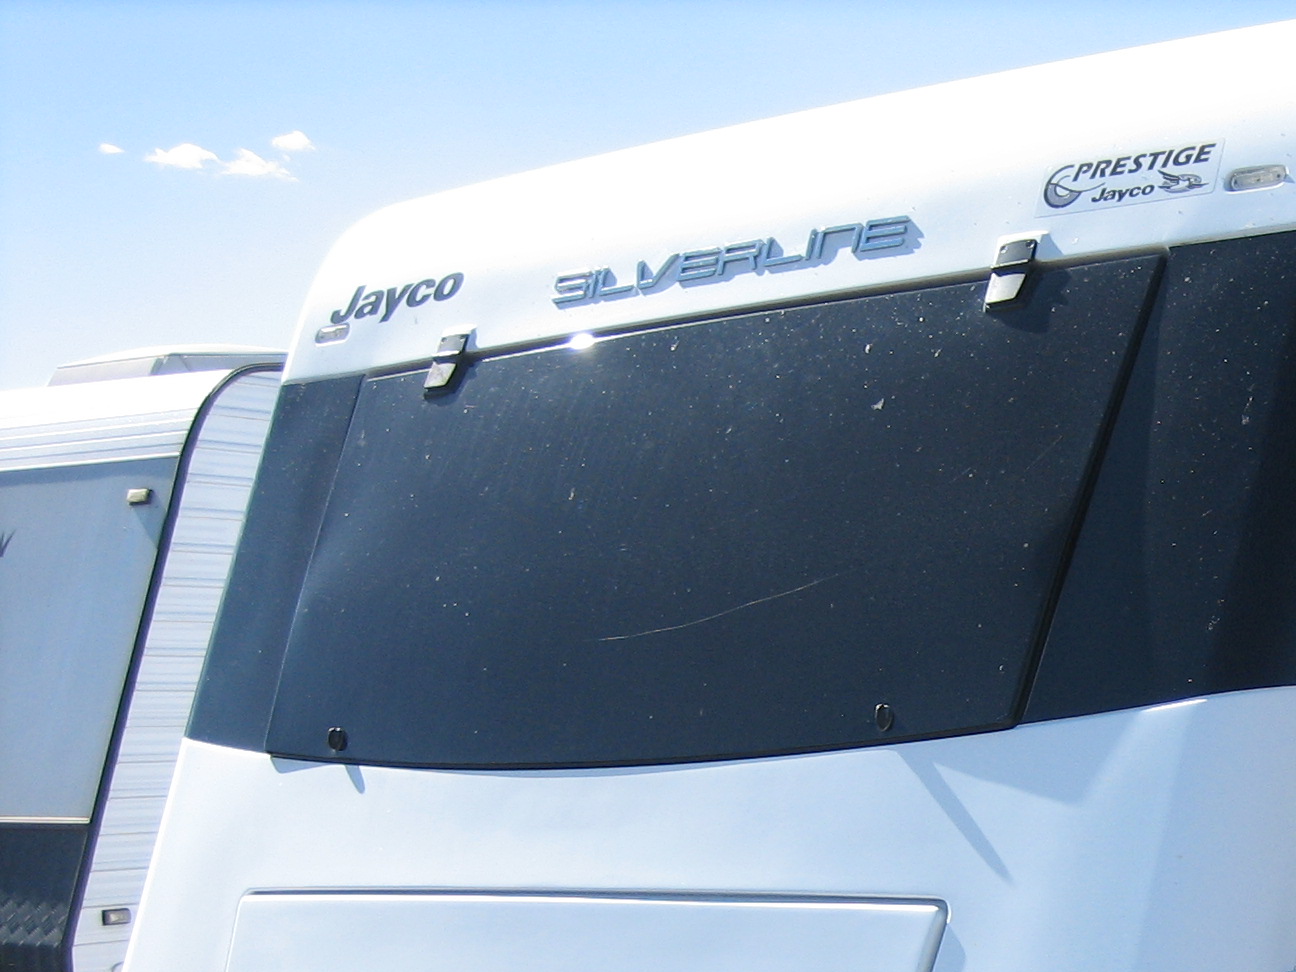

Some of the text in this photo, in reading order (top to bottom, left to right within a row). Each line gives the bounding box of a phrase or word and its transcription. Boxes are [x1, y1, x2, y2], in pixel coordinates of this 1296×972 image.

[1072, 143, 1217, 182] PRESTIGE
[1091, 183, 1155, 203] Jayco
[552, 215, 910, 304] SILVERLINE
[330, 272, 465, 325] Jayco
